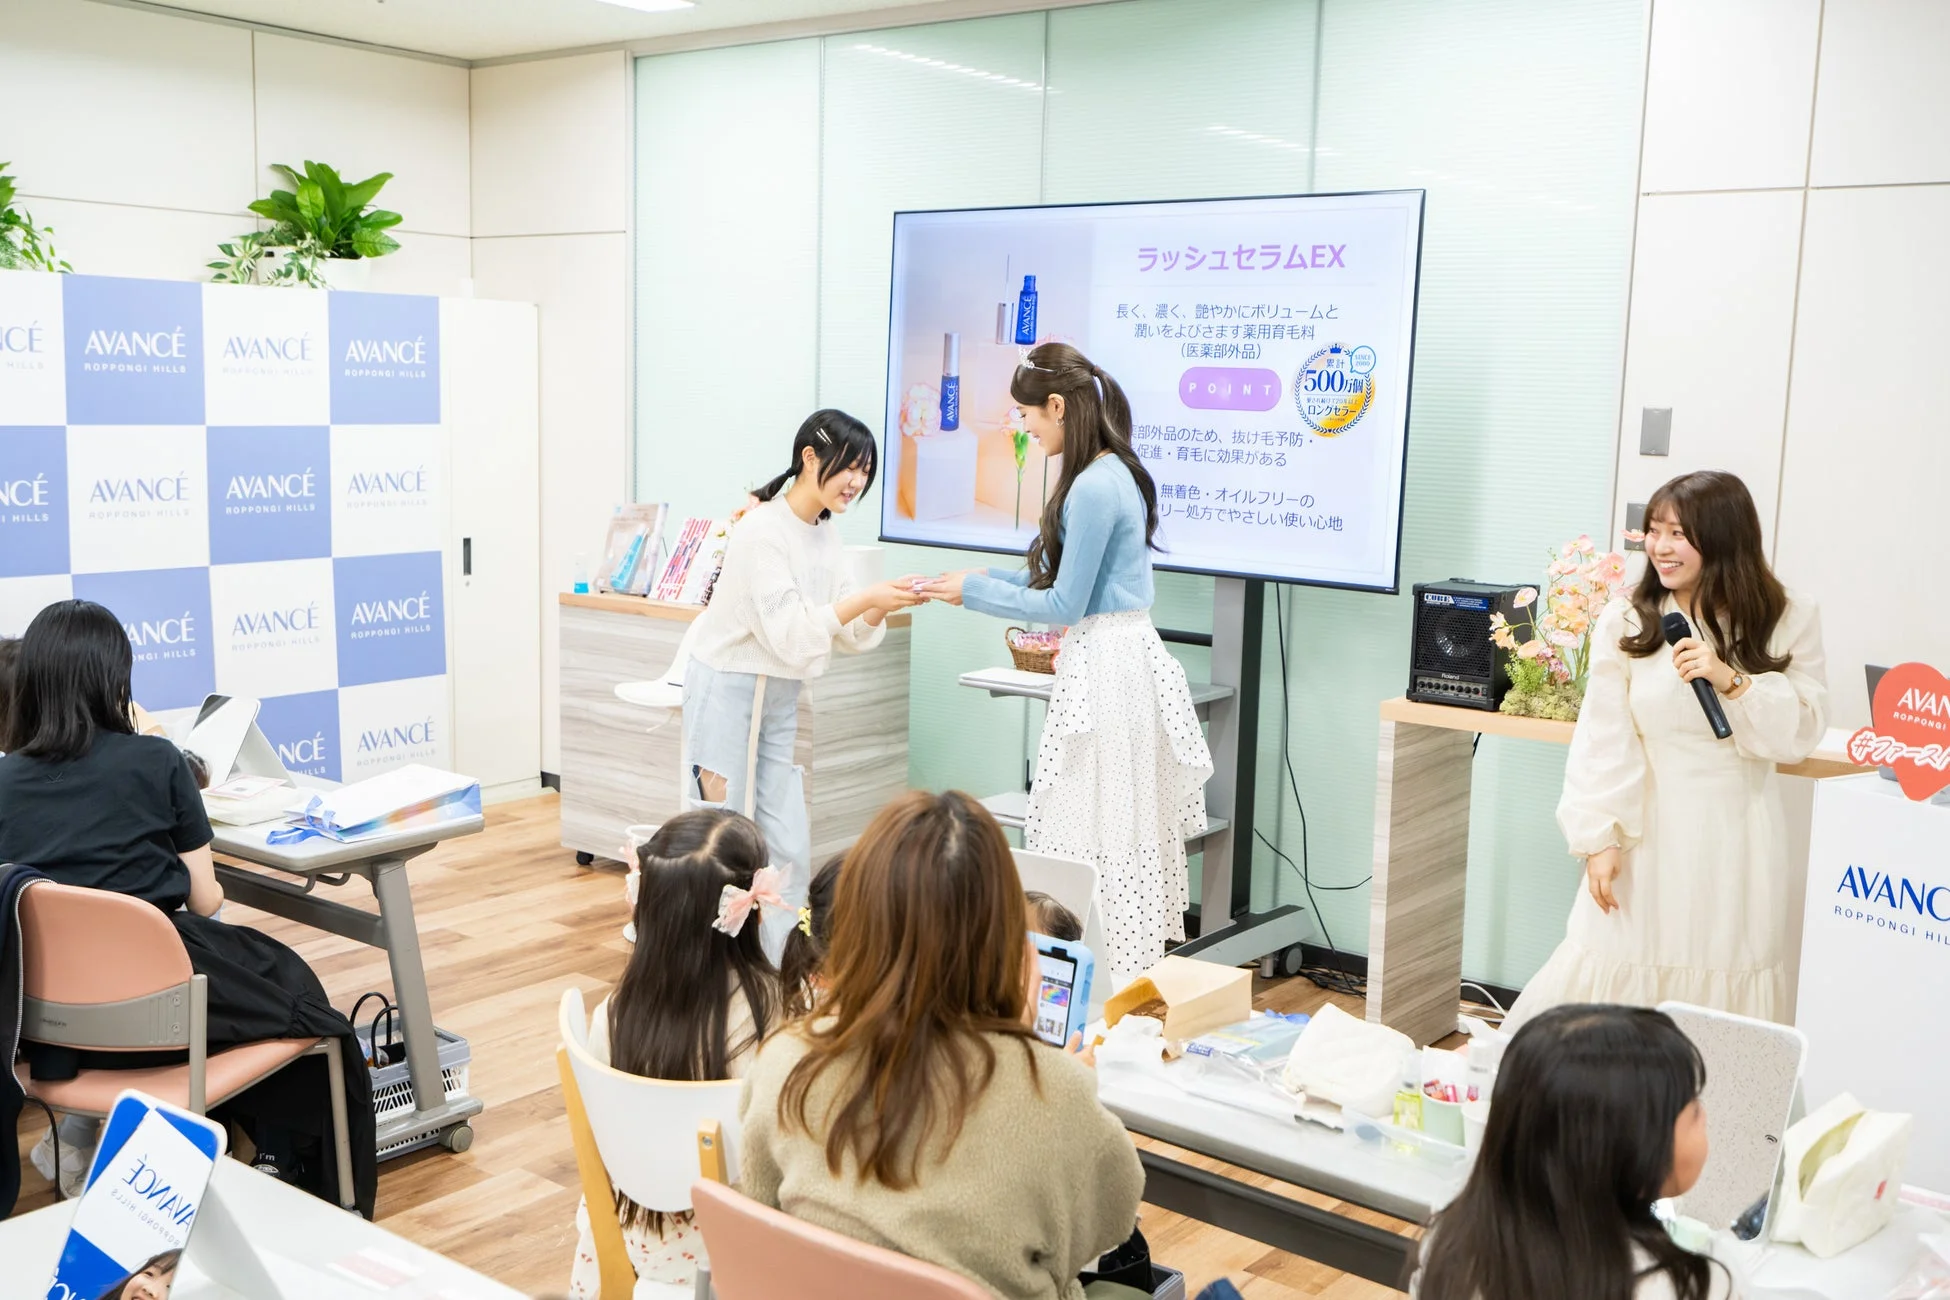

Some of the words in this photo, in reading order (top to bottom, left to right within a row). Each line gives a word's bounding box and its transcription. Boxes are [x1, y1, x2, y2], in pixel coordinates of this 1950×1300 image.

[1138, 243, 1347, 272] ラッシュセラムEX
[85, 325, 187, 358] AVANCÉ
[1134, 323, 1315, 341] 潤いをよびさます薬用育毛料
[223, 332, 313, 362] AVANCÉ
[345, 335, 426, 364] AVANCÉ
[84, 361, 148, 373] ROPPONGI
[152, 363, 187, 374] HILLS
[345, 368, 395, 378] ROPPONGI
[399, 370, 426, 378] HILLS
[1326, 358, 1345, 369] 累計
[1188, 382, 1272, 396] POINT
[1304, 369, 1364, 394] 500万個
[1308, 405, 1357, 417] ロングセラー
[1134, 443, 1287, 467] 促進・育毛に効果がある
[89, 470, 190, 503] AVANCÉ
[226, 466, 316, 500] AVANCÉ
[347, 464, 427, 495] AVANCÉ
[12, 512, 49, 523] HILLS
[88, 510, 151, 521] ROPPONGI
[156, 508, 190, 517] HILLS
[226, 505, 281, 515] ROPPONGI
[286, 502, 316, 512] HILLS
[1156, 503, 1343, 532] リー処方でやさしい使い心地
[232, 601, 320, 636] AVANCÉ
[351, 590, 431, 625] AVANCÉ
[231, 639, 287, 652] ROPPONGI
[291, 636, 321, 646] HILLS
[351, 628, 401, 640] ROPPONGI
[404, 624, 431, 633] HILLS
[163, 648, 196, 660] HILLS
[1893, 711, 1947, 731] ROPPONGI
[357, 715, 436, 752] AVANCÉ
[1834, 905, 1915, 937] ROPPONGI
